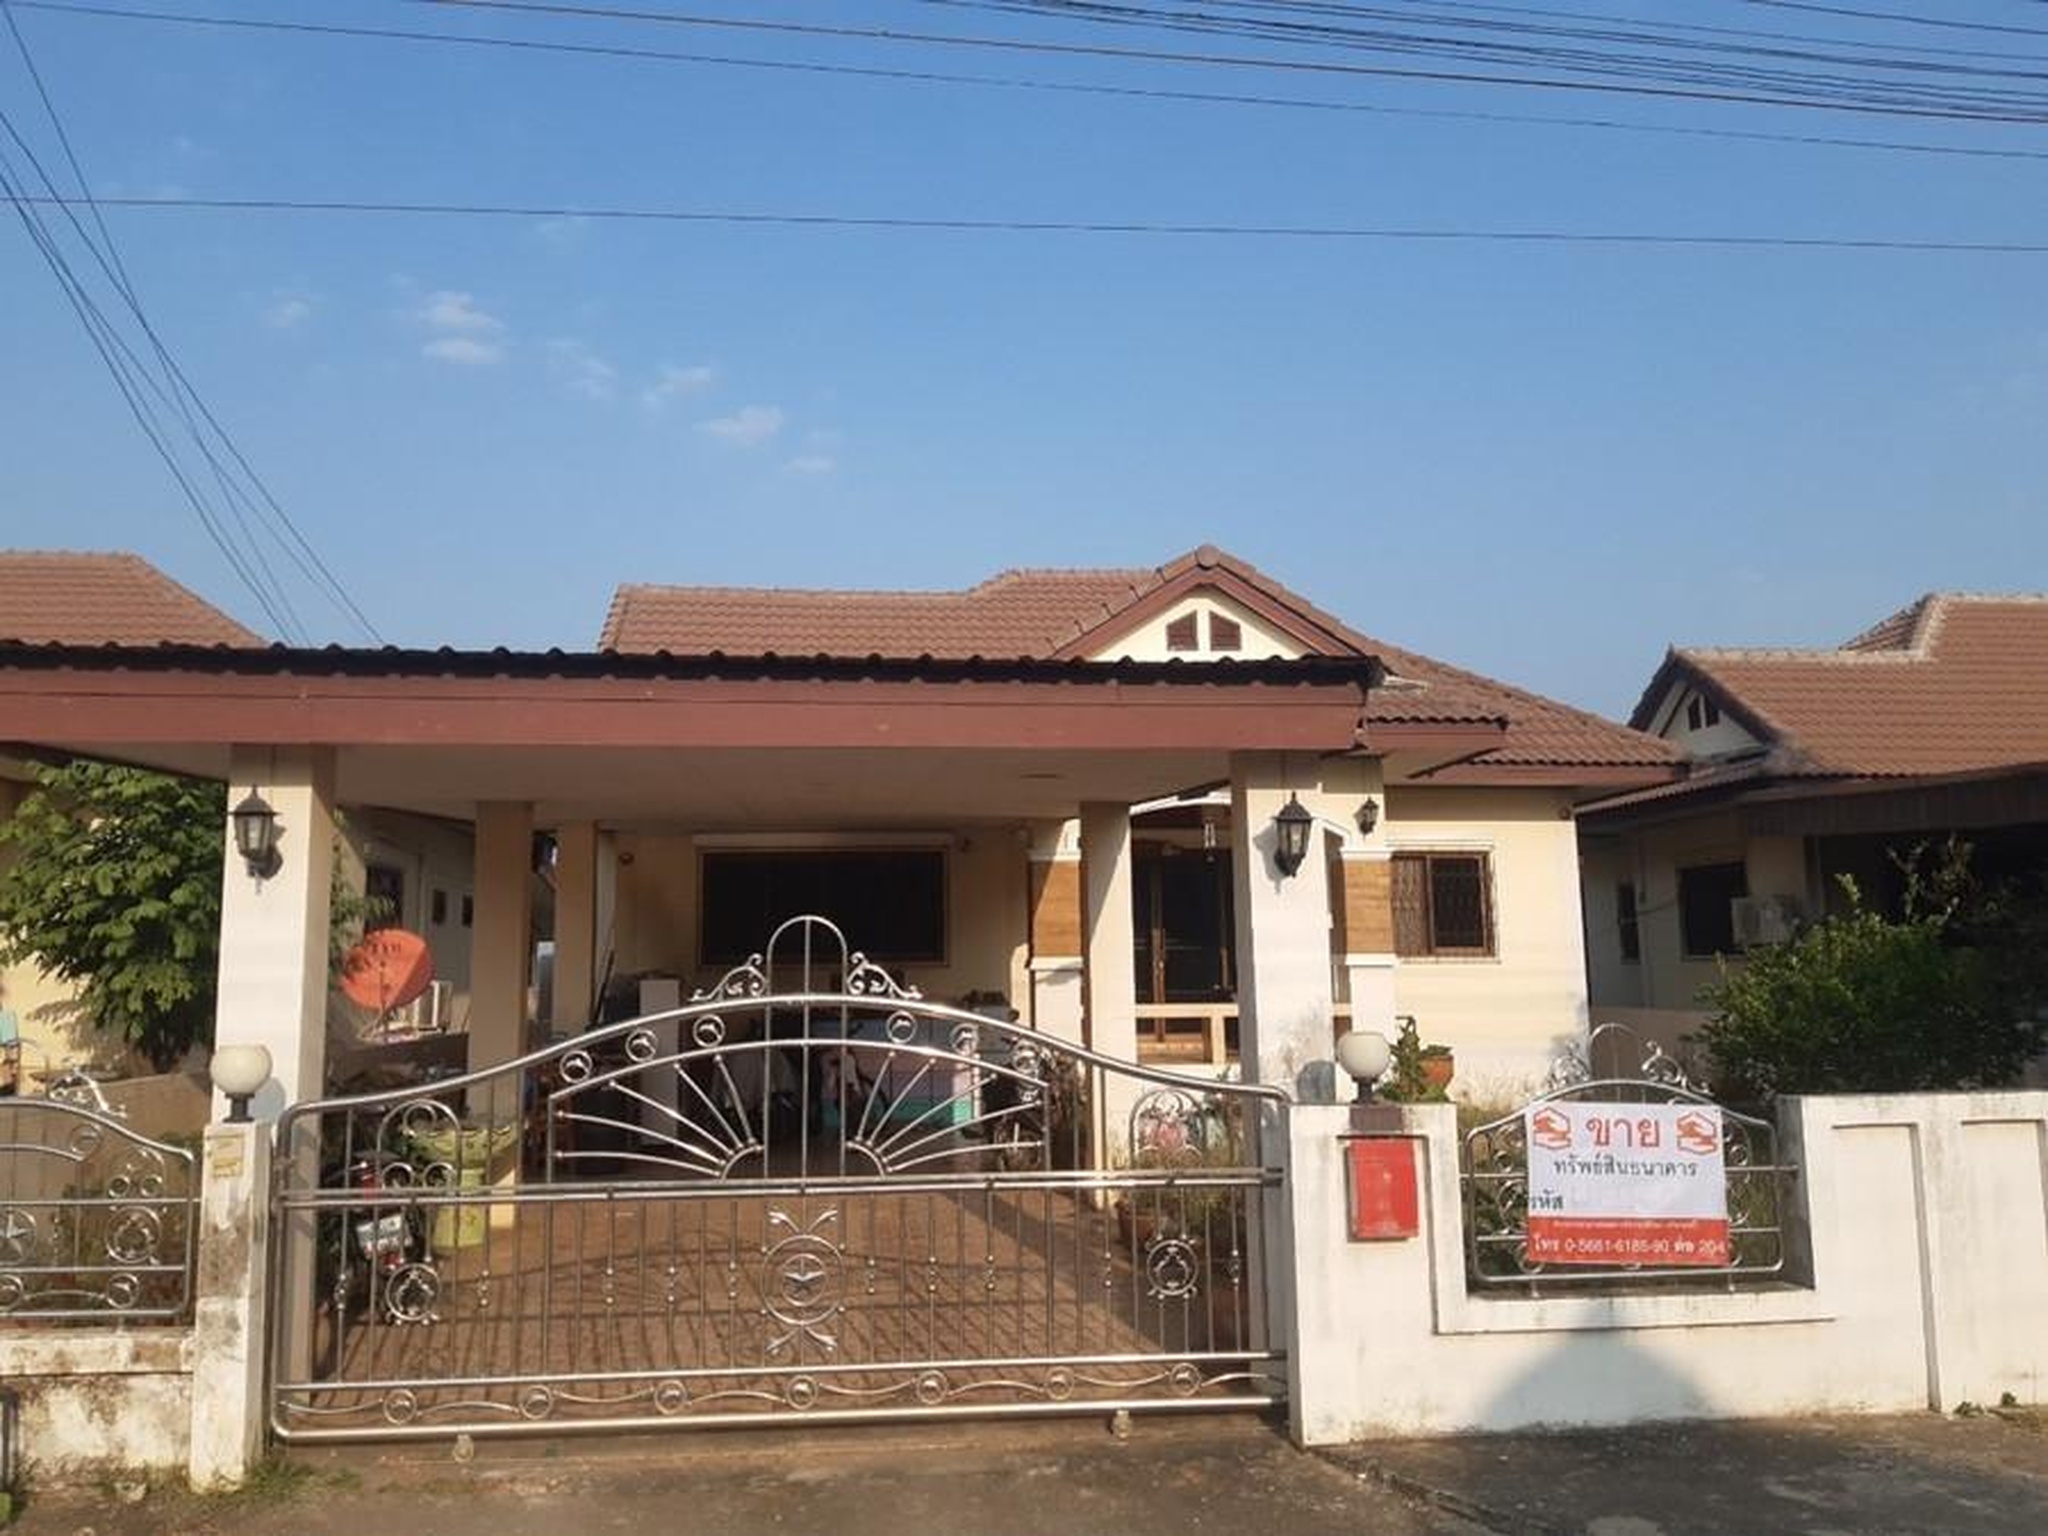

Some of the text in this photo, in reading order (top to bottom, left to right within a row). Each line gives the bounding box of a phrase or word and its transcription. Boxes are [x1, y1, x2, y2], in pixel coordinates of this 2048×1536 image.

[1586, 1114, 1660, 1148] ขาย
[1553, 1153, 1698, 1177] ทรัพย์สินธนาคาร
